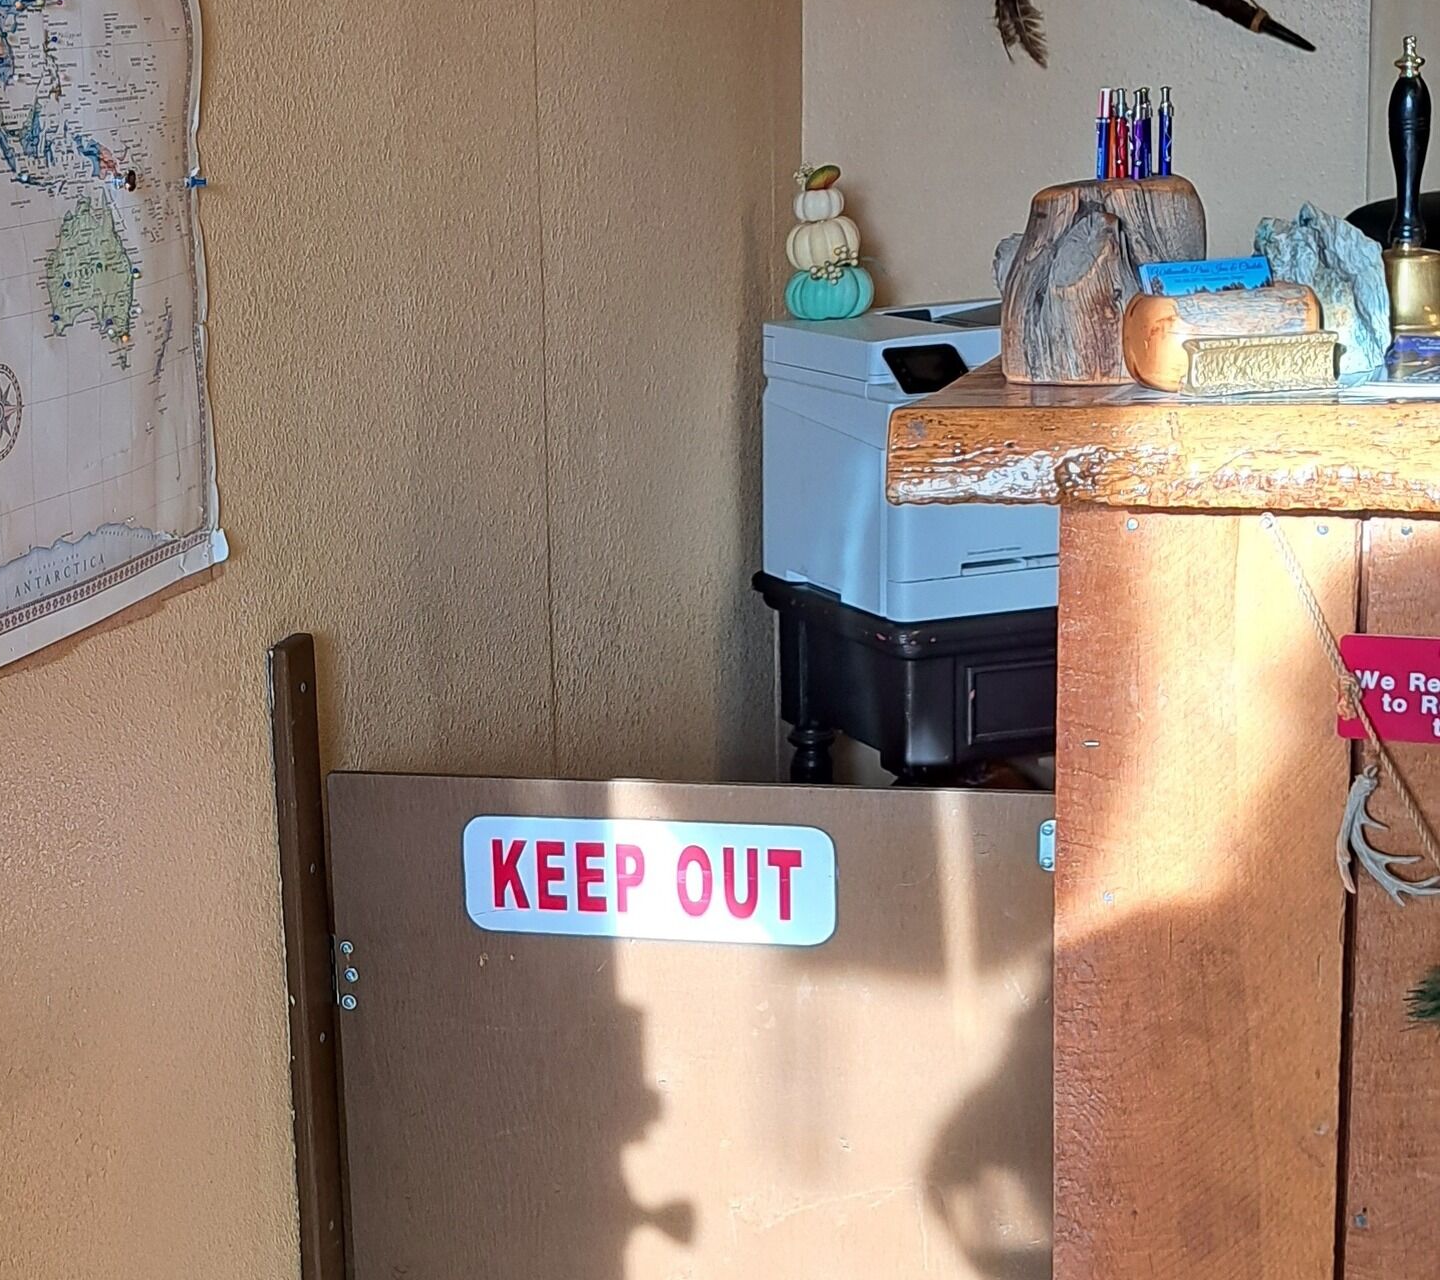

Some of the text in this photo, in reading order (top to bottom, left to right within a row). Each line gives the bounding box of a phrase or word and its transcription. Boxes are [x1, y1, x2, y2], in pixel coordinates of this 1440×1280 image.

[14, 552, 106, 599] ANTARCTICA
[1354, 669, 1396, 691] We
[1381, 692, 1408, 713] to
[492, 839, 802, 921] KEEP OUT
